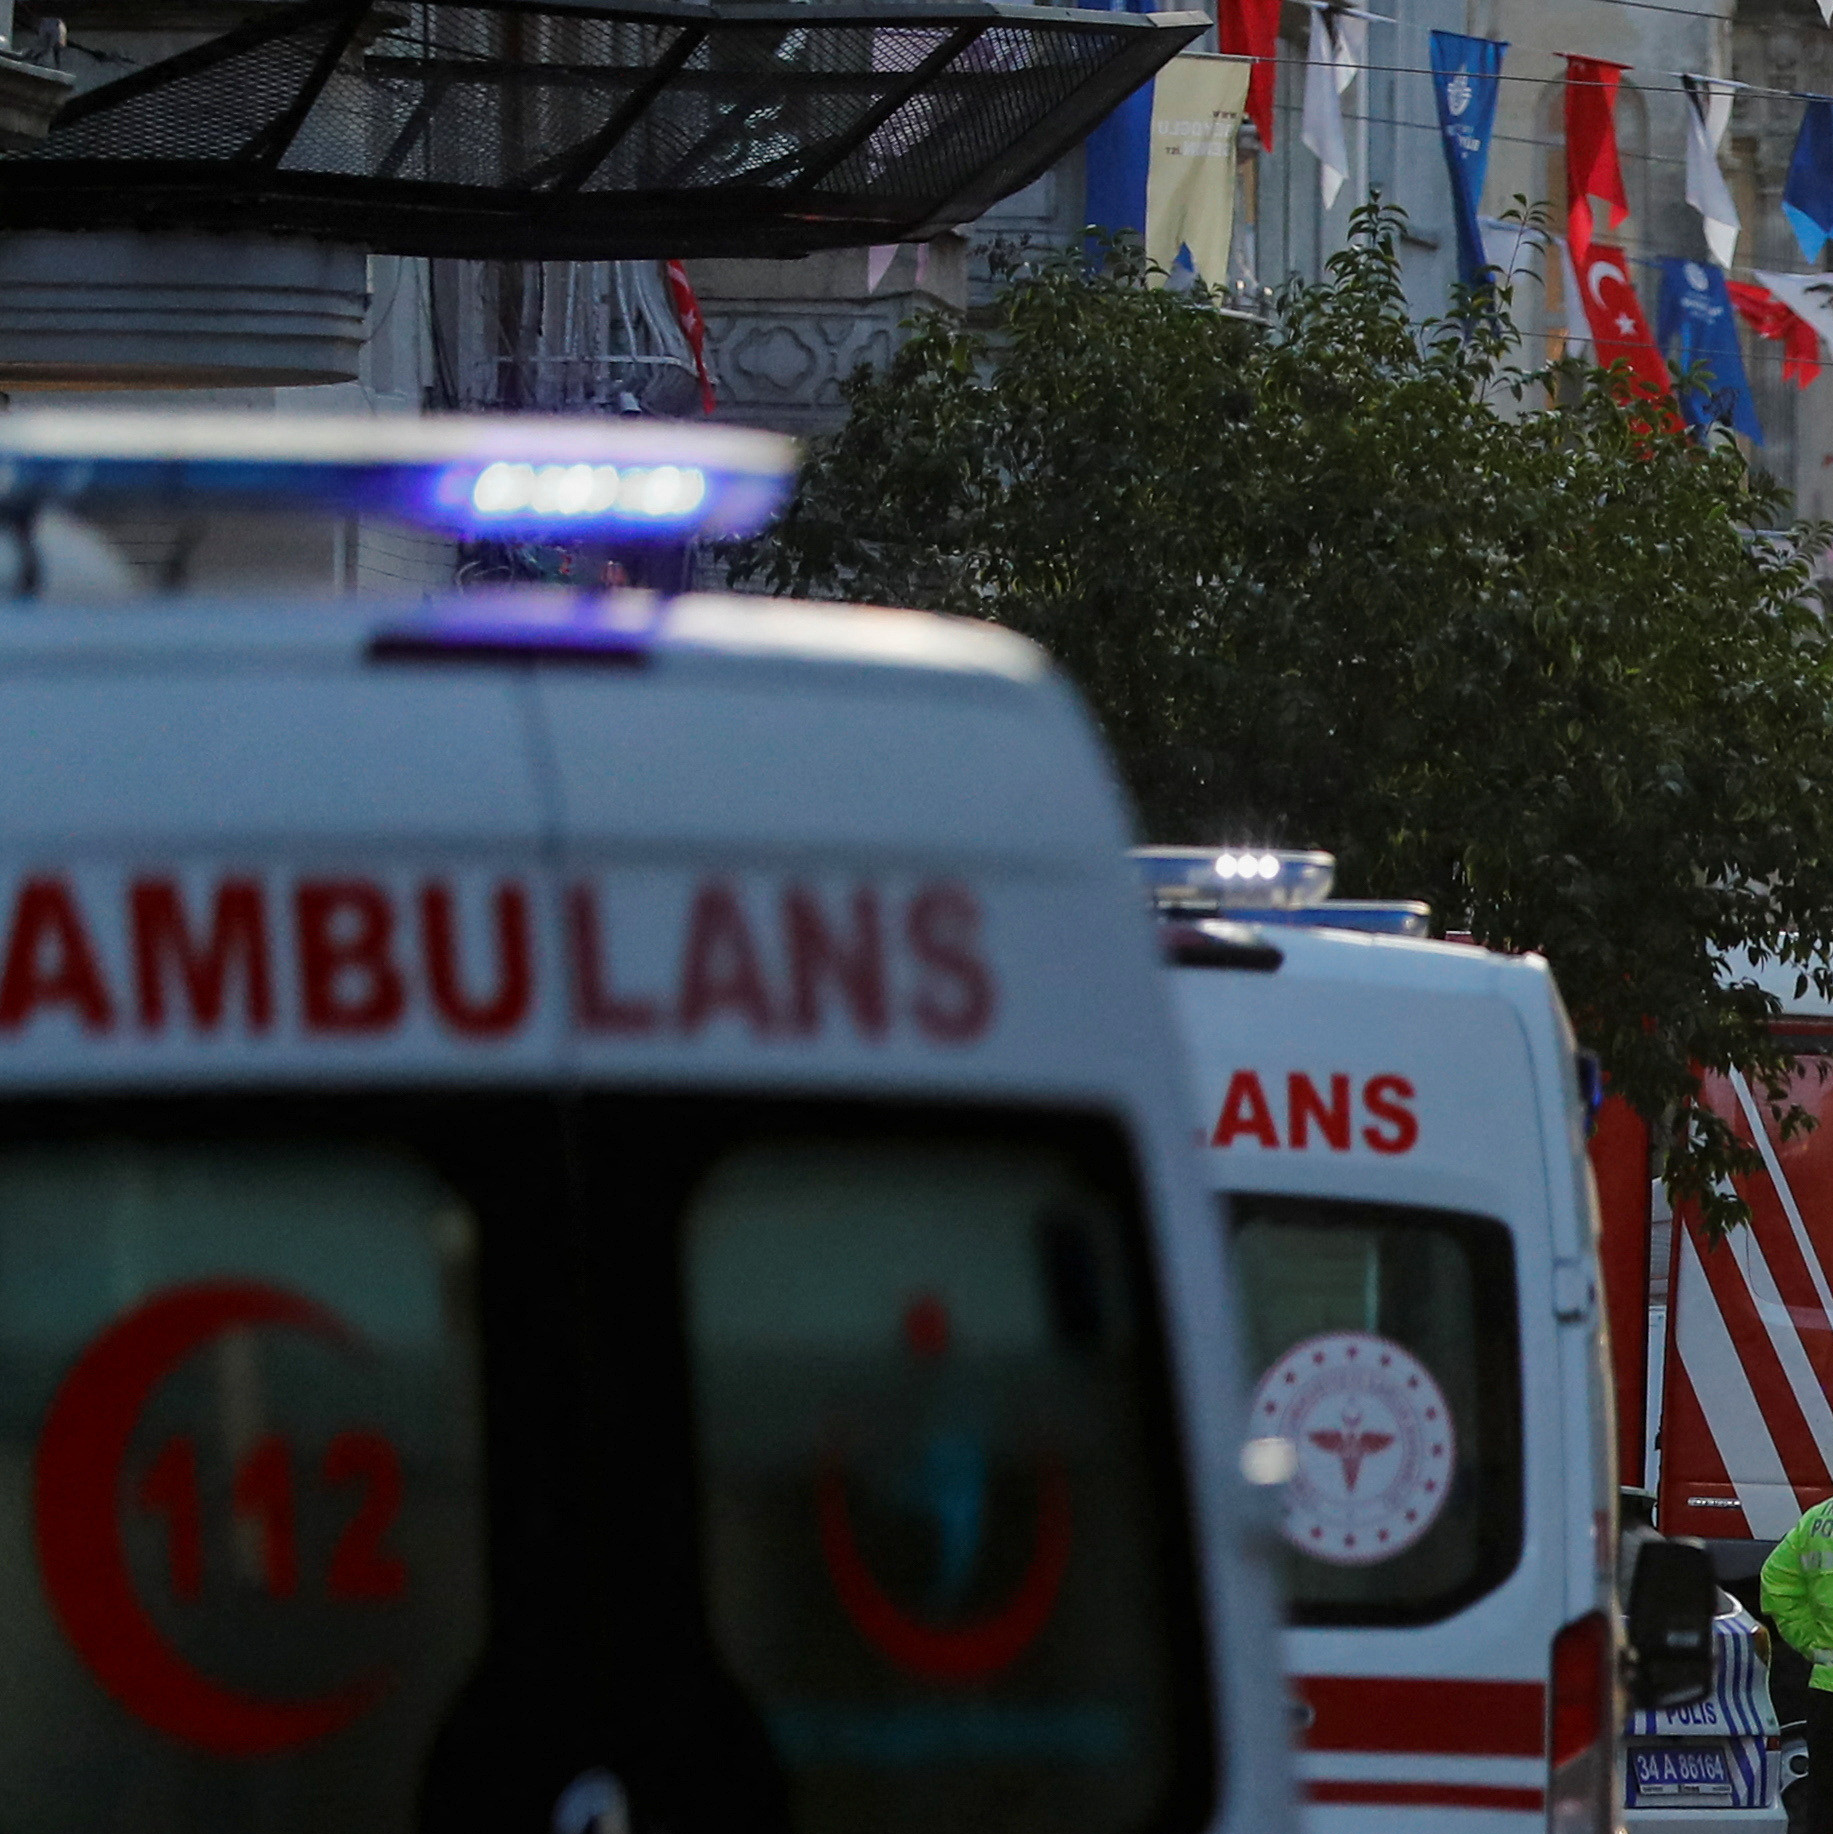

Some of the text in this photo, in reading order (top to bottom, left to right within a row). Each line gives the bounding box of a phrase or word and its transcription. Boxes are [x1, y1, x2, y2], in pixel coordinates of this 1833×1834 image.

[0, 874, 997, 1046] AMBULANS
[138, 1432, 408, 1601] 112
[1637, 1755, 1659, 1781] 34
[1664, 1753, 1678, 1780] A
